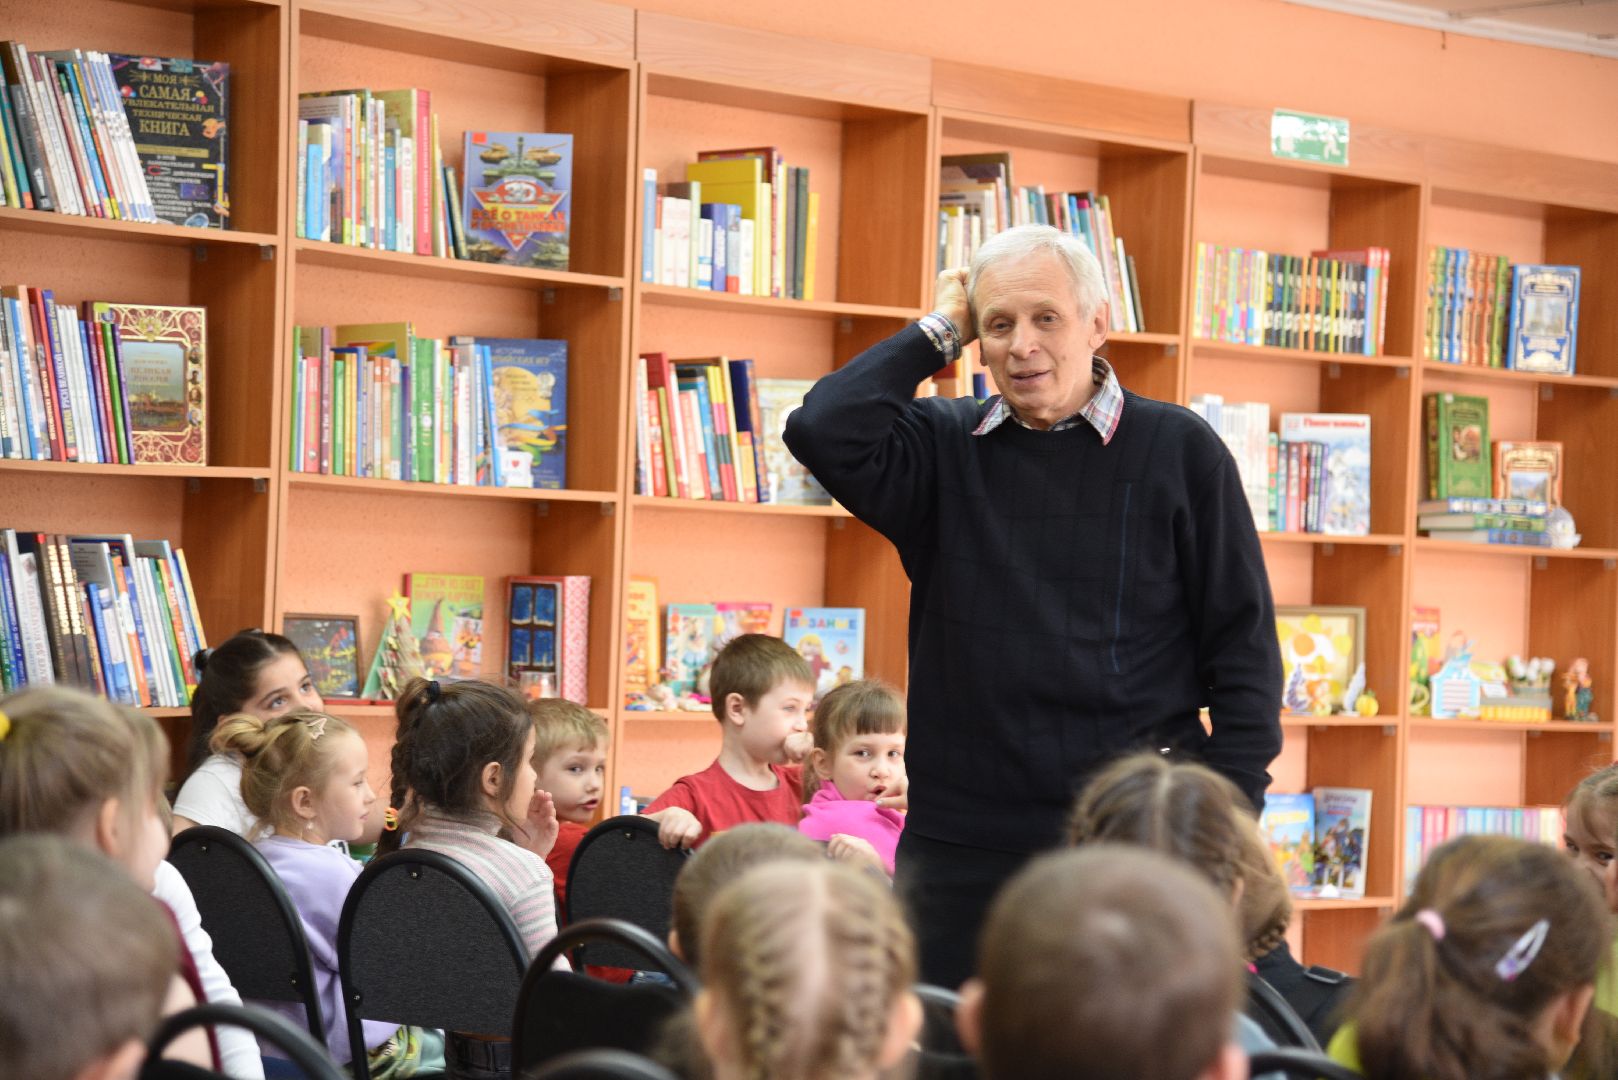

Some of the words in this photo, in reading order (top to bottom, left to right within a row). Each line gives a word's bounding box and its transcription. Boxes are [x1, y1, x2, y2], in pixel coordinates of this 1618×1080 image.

[153, 73, 177, 84] МОЯ
[139, 85, 191, 101] САМАЯ
[133, 108, 202, 122] ТЕХНИЧЕСКАЯ
[139, 120, 191, 137] КНИГА
